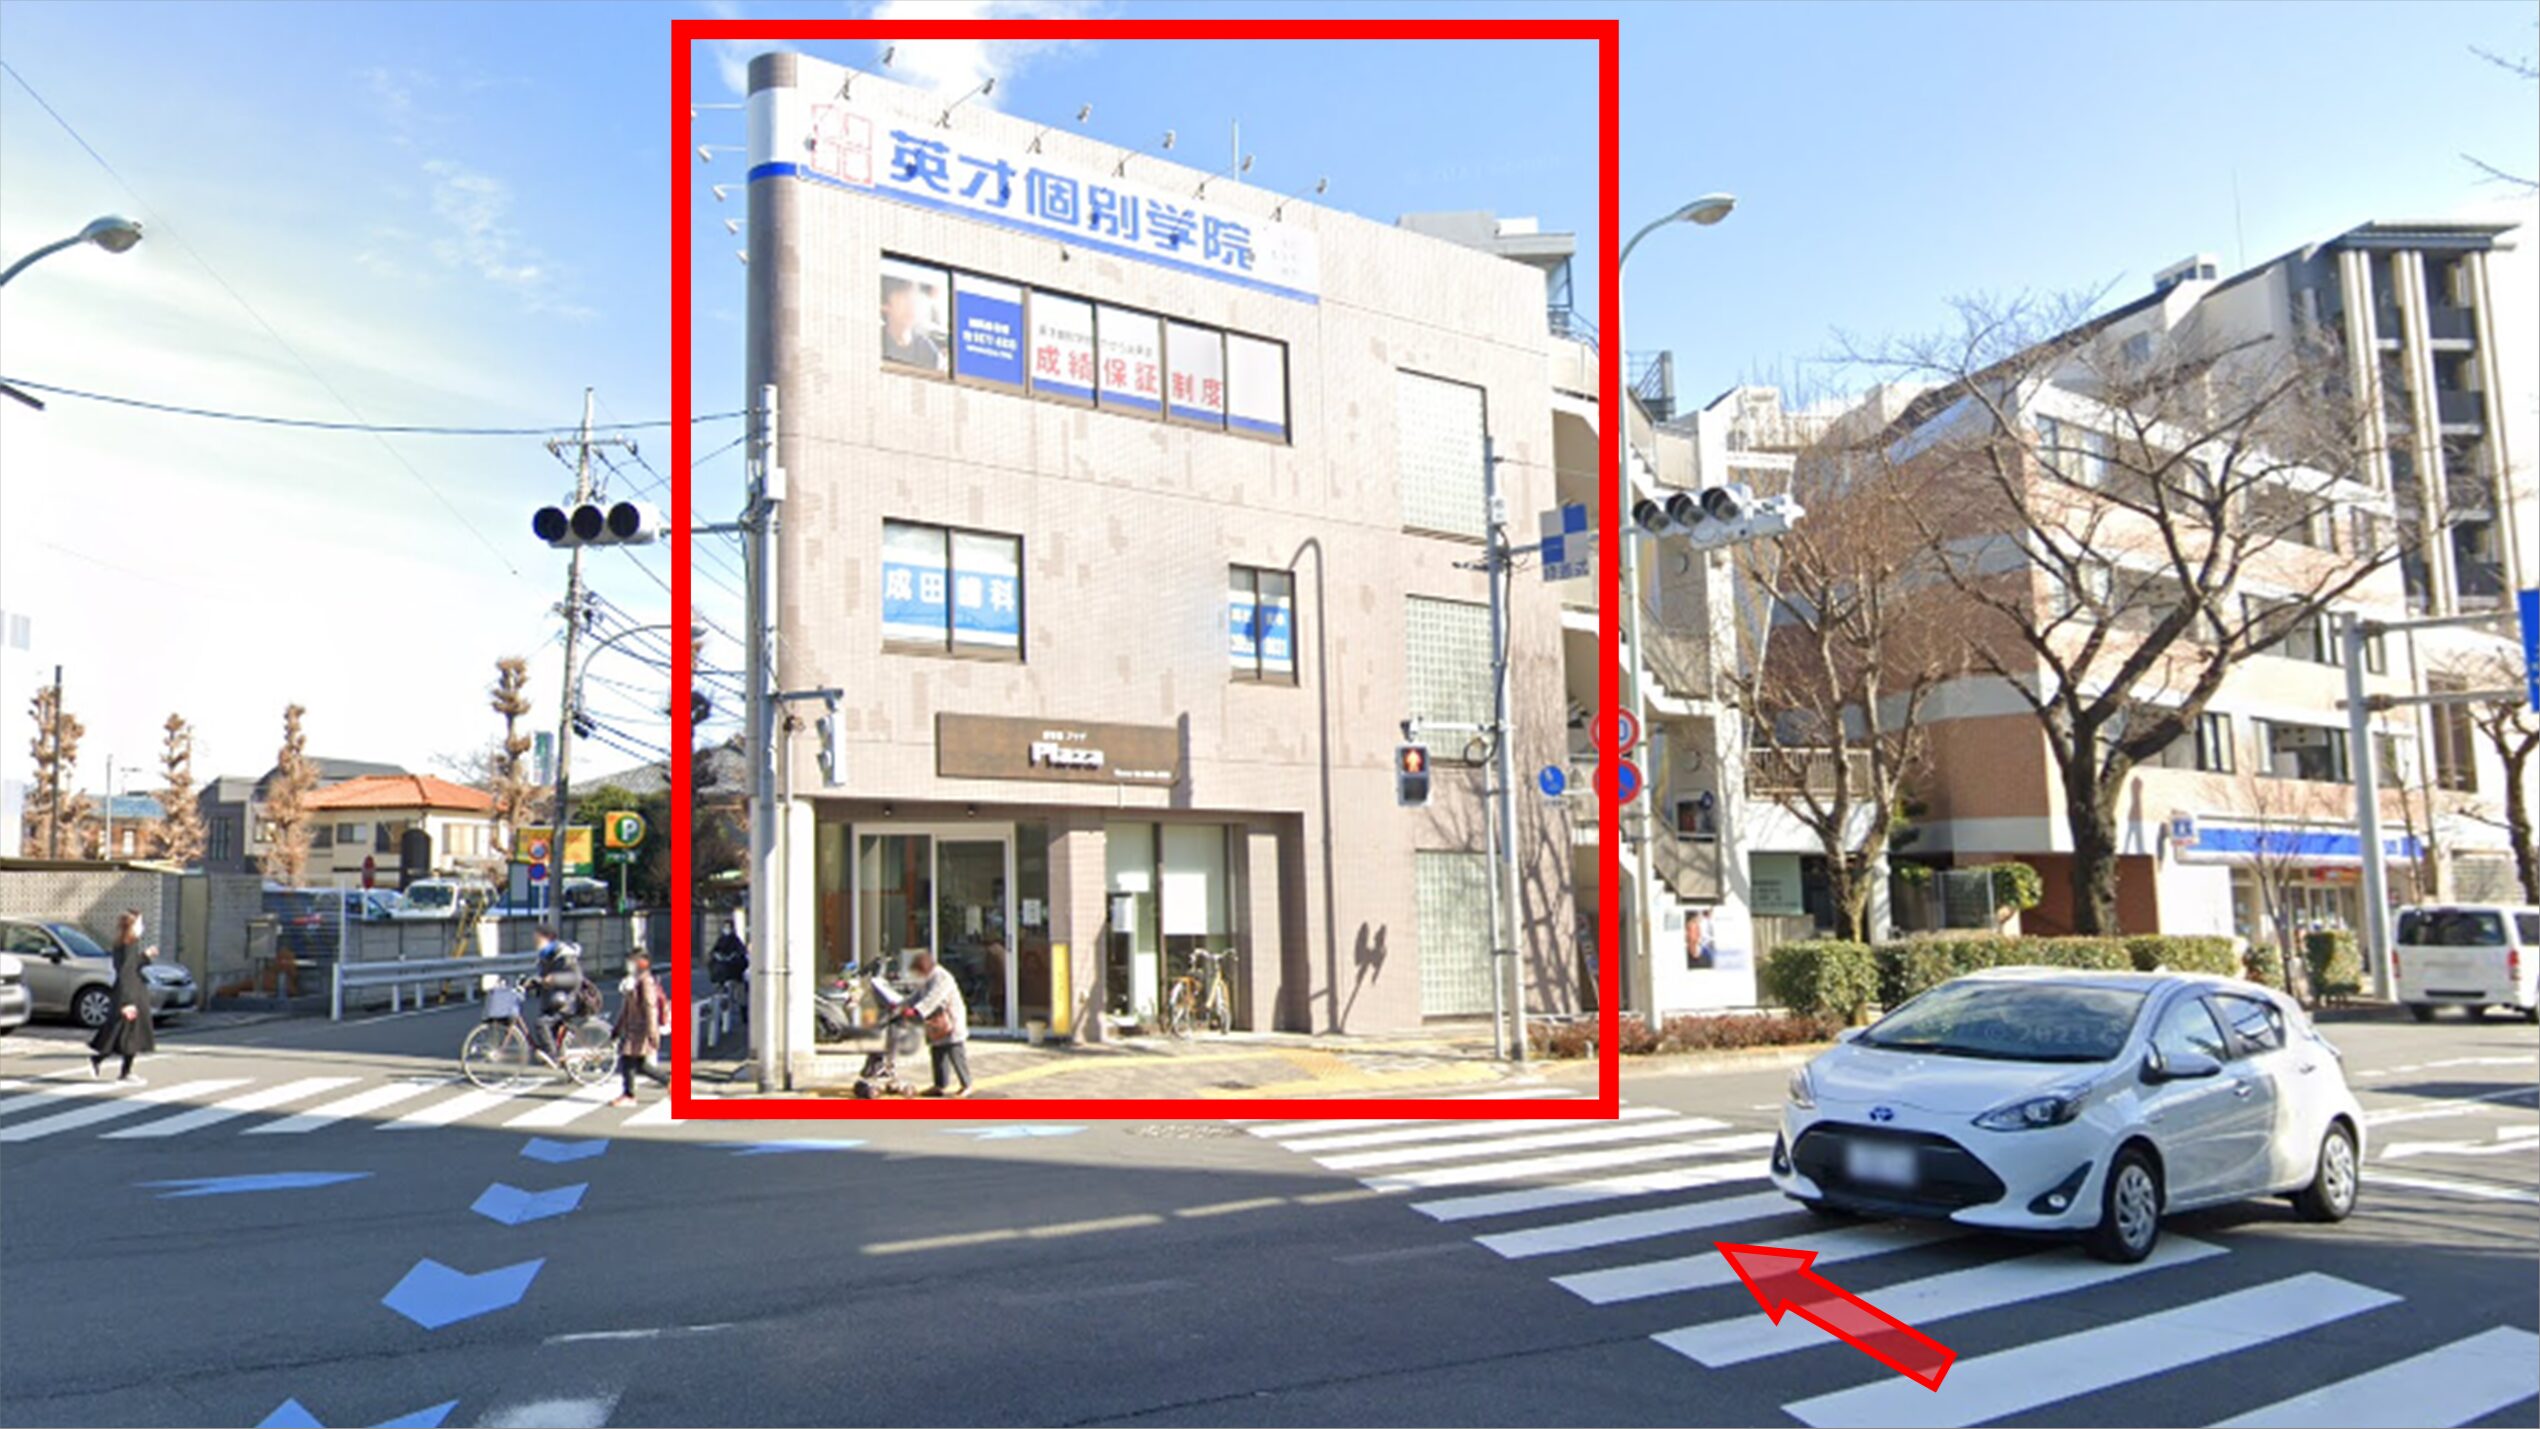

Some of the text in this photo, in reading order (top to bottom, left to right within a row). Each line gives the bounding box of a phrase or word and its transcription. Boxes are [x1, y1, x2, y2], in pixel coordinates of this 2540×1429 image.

[889, 128, 1255, 271] 英才個別学院
[621, 818, 638, 841] P
